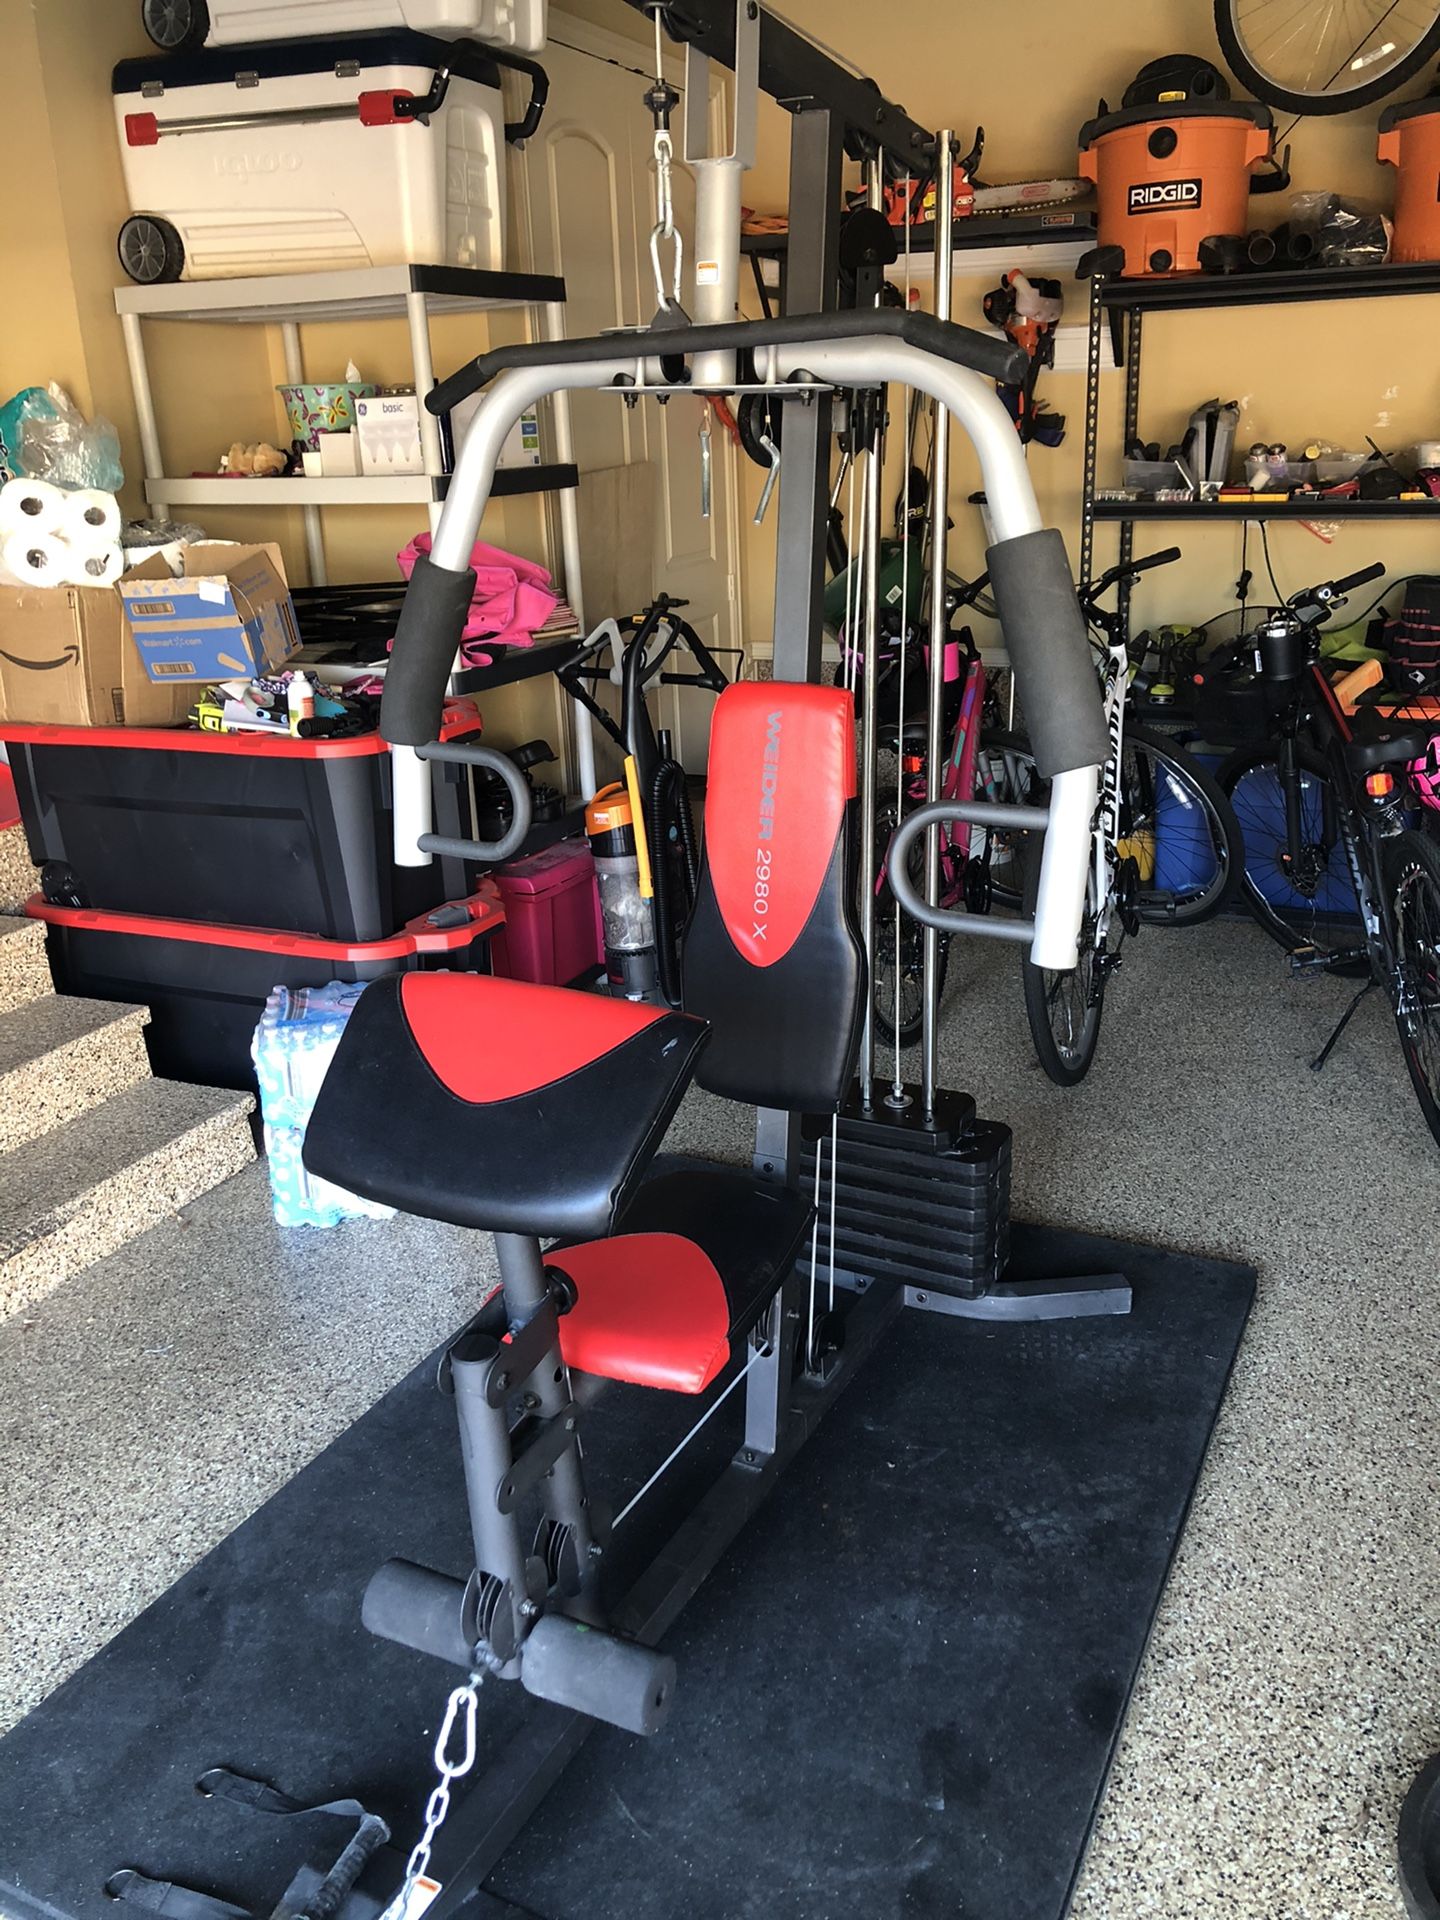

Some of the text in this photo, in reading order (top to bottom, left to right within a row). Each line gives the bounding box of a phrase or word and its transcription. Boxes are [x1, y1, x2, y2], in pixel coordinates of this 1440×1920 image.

[1130, 183, 1198, 205] RIDGID
[381, 402, 405, 414] basic
[752, 711, 782, 941] WEIDER 2980 X
